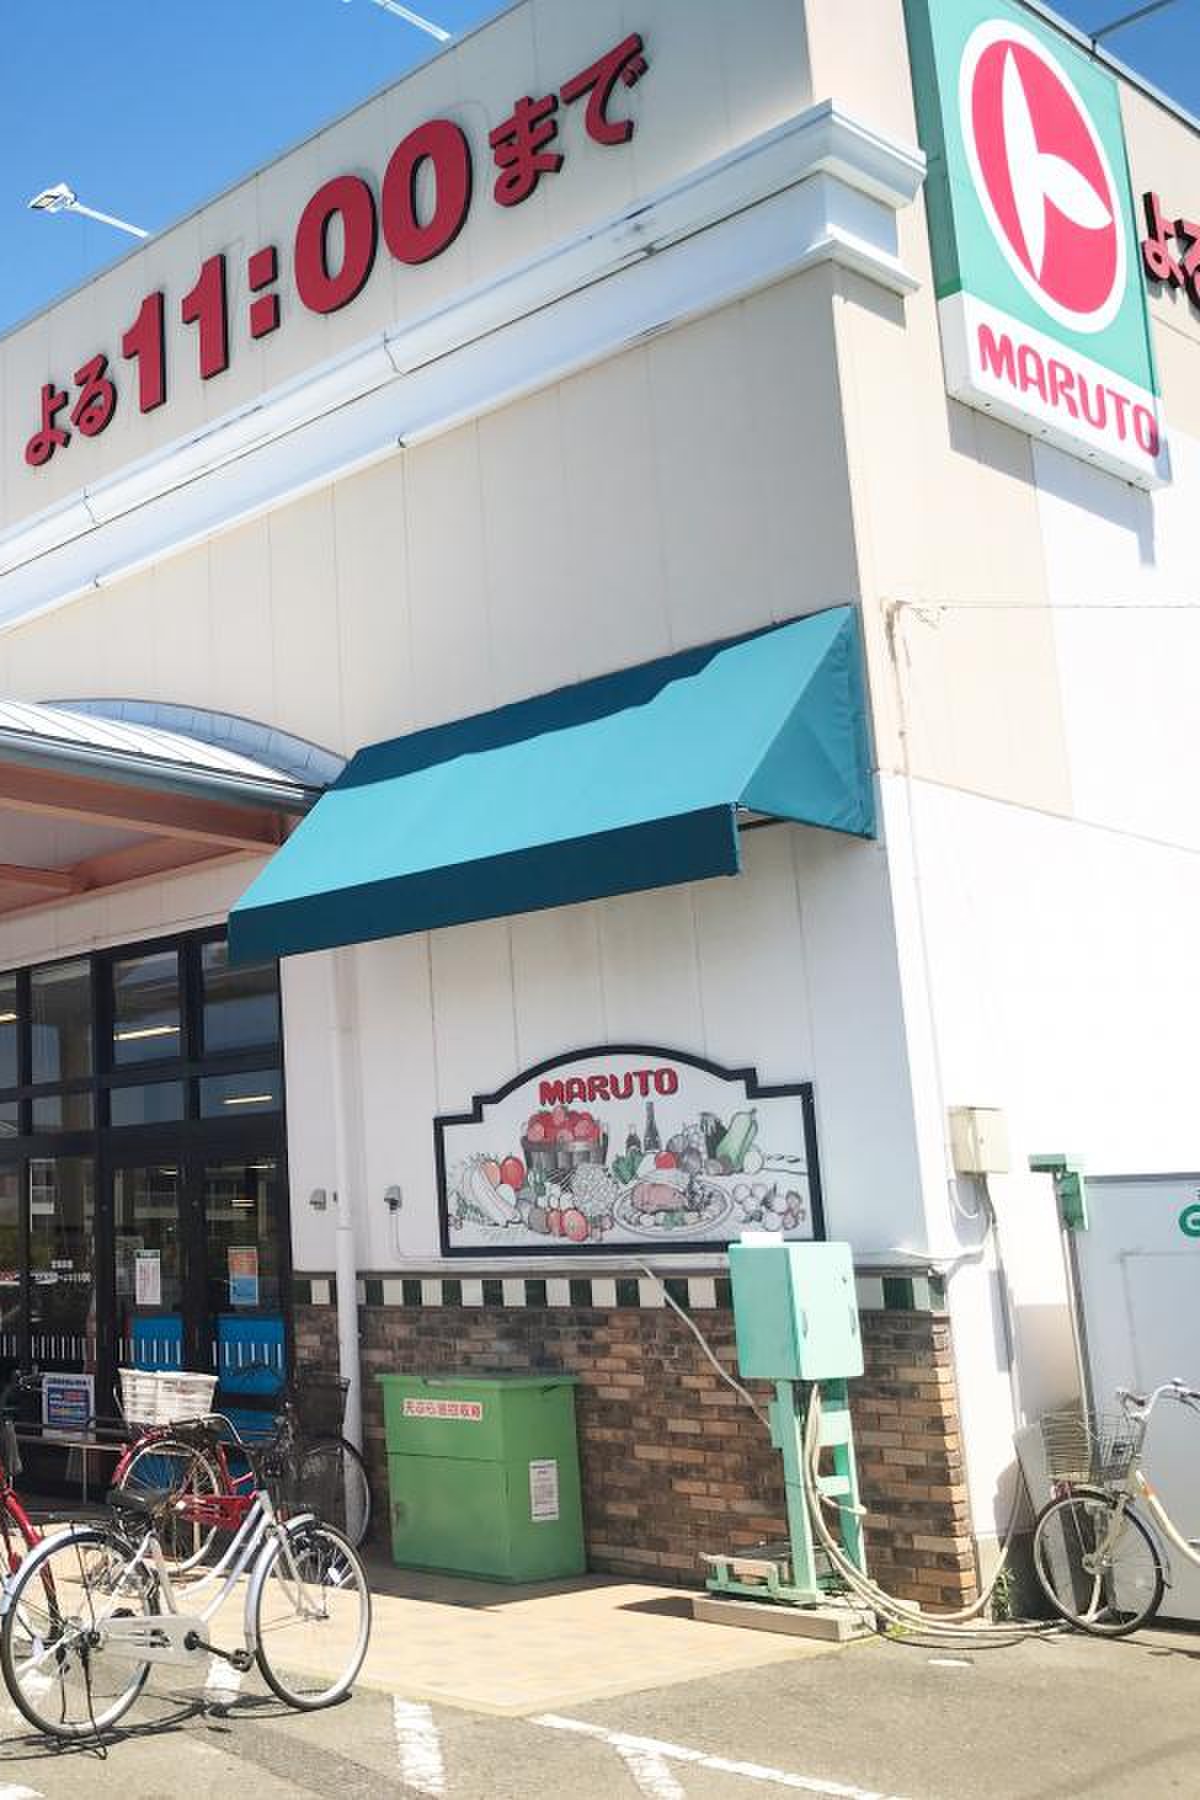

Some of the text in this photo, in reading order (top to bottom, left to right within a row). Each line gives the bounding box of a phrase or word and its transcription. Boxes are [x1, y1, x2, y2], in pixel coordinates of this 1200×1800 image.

[24, 32, 648, 467] よる11:00まで
[978, 323, 1161, 458] MARUTO
[538, 1067, 679, 1106] MARUTO
